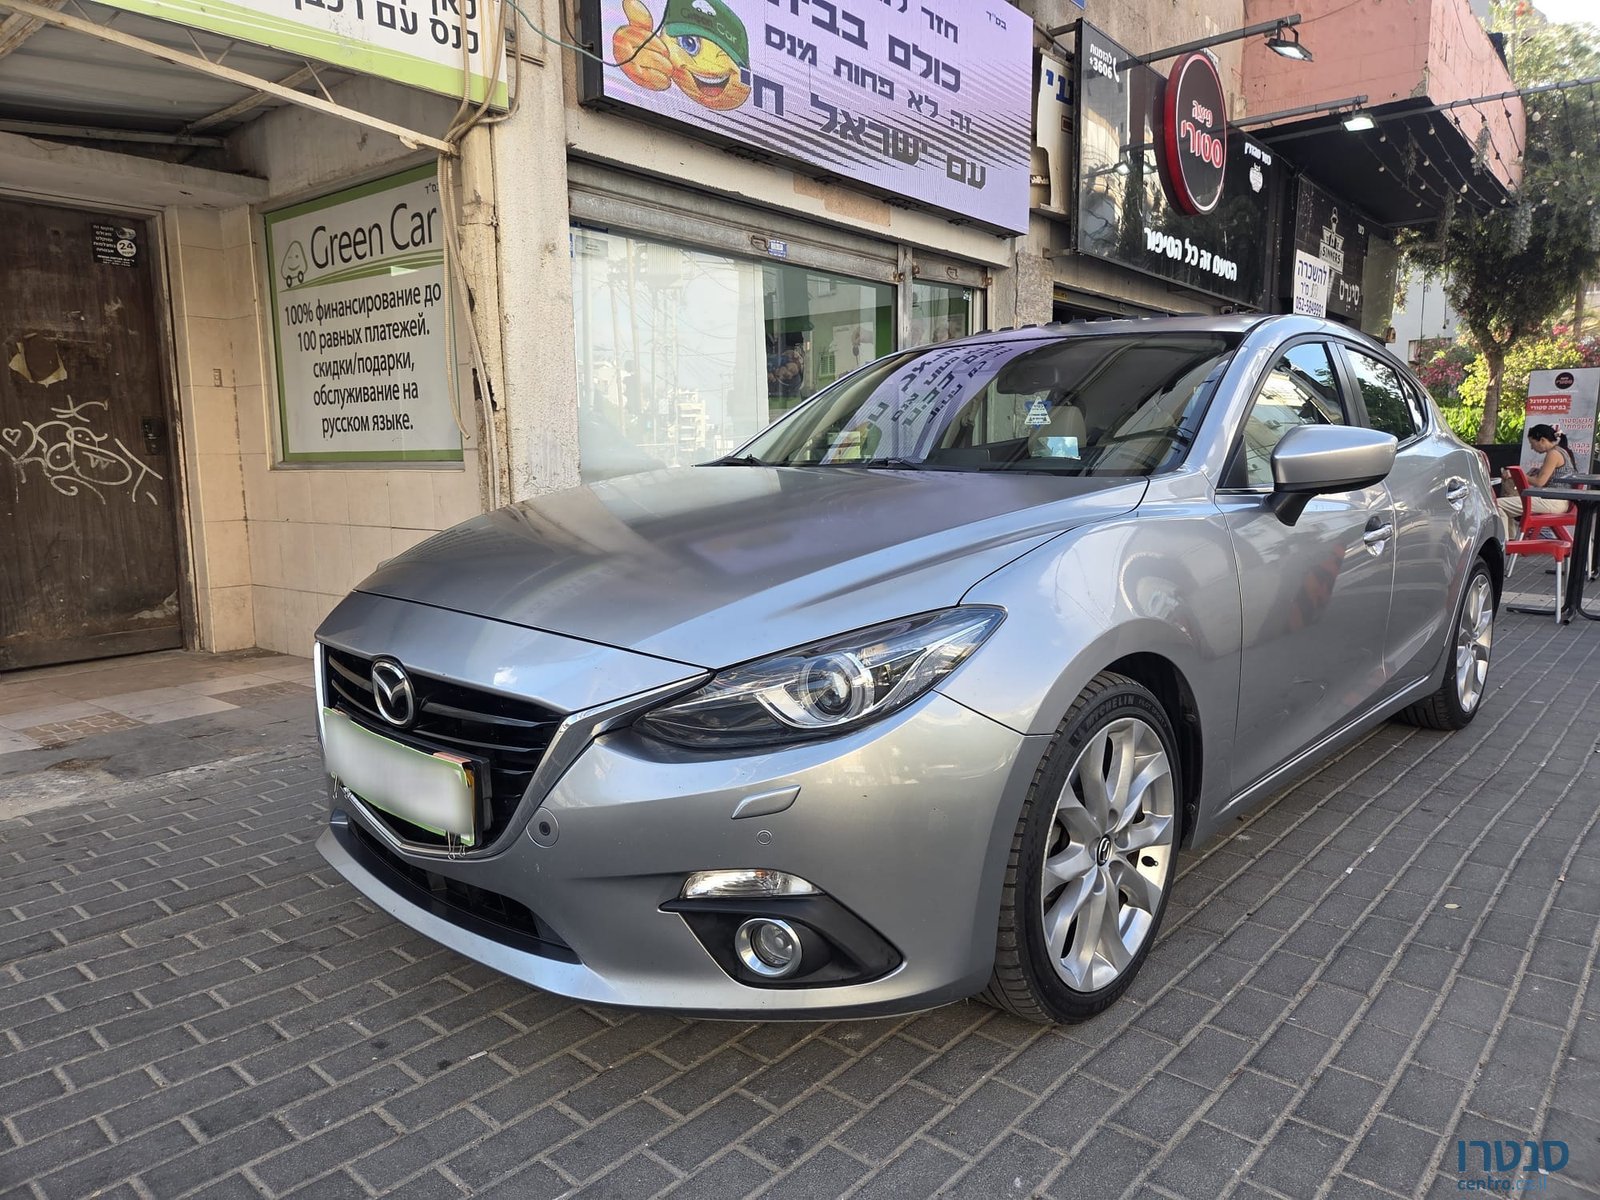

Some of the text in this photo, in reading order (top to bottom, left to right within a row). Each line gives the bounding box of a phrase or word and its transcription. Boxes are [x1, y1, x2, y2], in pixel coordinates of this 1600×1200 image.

[376, 0, 418, 35] עם
[716, 22, 737, 44] Car
[920, 6, 958, 44] חזר
[429, 18, 479, 54] כנס
[765, 23, 972, 135] זה לא פחות מנס
[888, 34, 961, 93] כולם
[739, 66, 986, 190] עם ישראל חי
[1192, 100, 1213, 128] פיצה
[1181, 120, 1223, 168] סטורי
[119, 242, 134, 250] 24
[310, 202, 437, 269] Green Car
[1144, 226, 1238, 281] הטעם זה כל הסיפור
[1298, 260, 1327, 286] להשכרה
[284, 282, 442, 327] 100% финансирование до
[297, 312, 430, 354] 100 равных платежей.
[313, 351, 415, 380] скидки/подарки,
[313, 381, 419, 410] обслуживание на
[321, 412, 414, 439] русском языке.
[1087, 695, 1135, 726] MICHELIN
